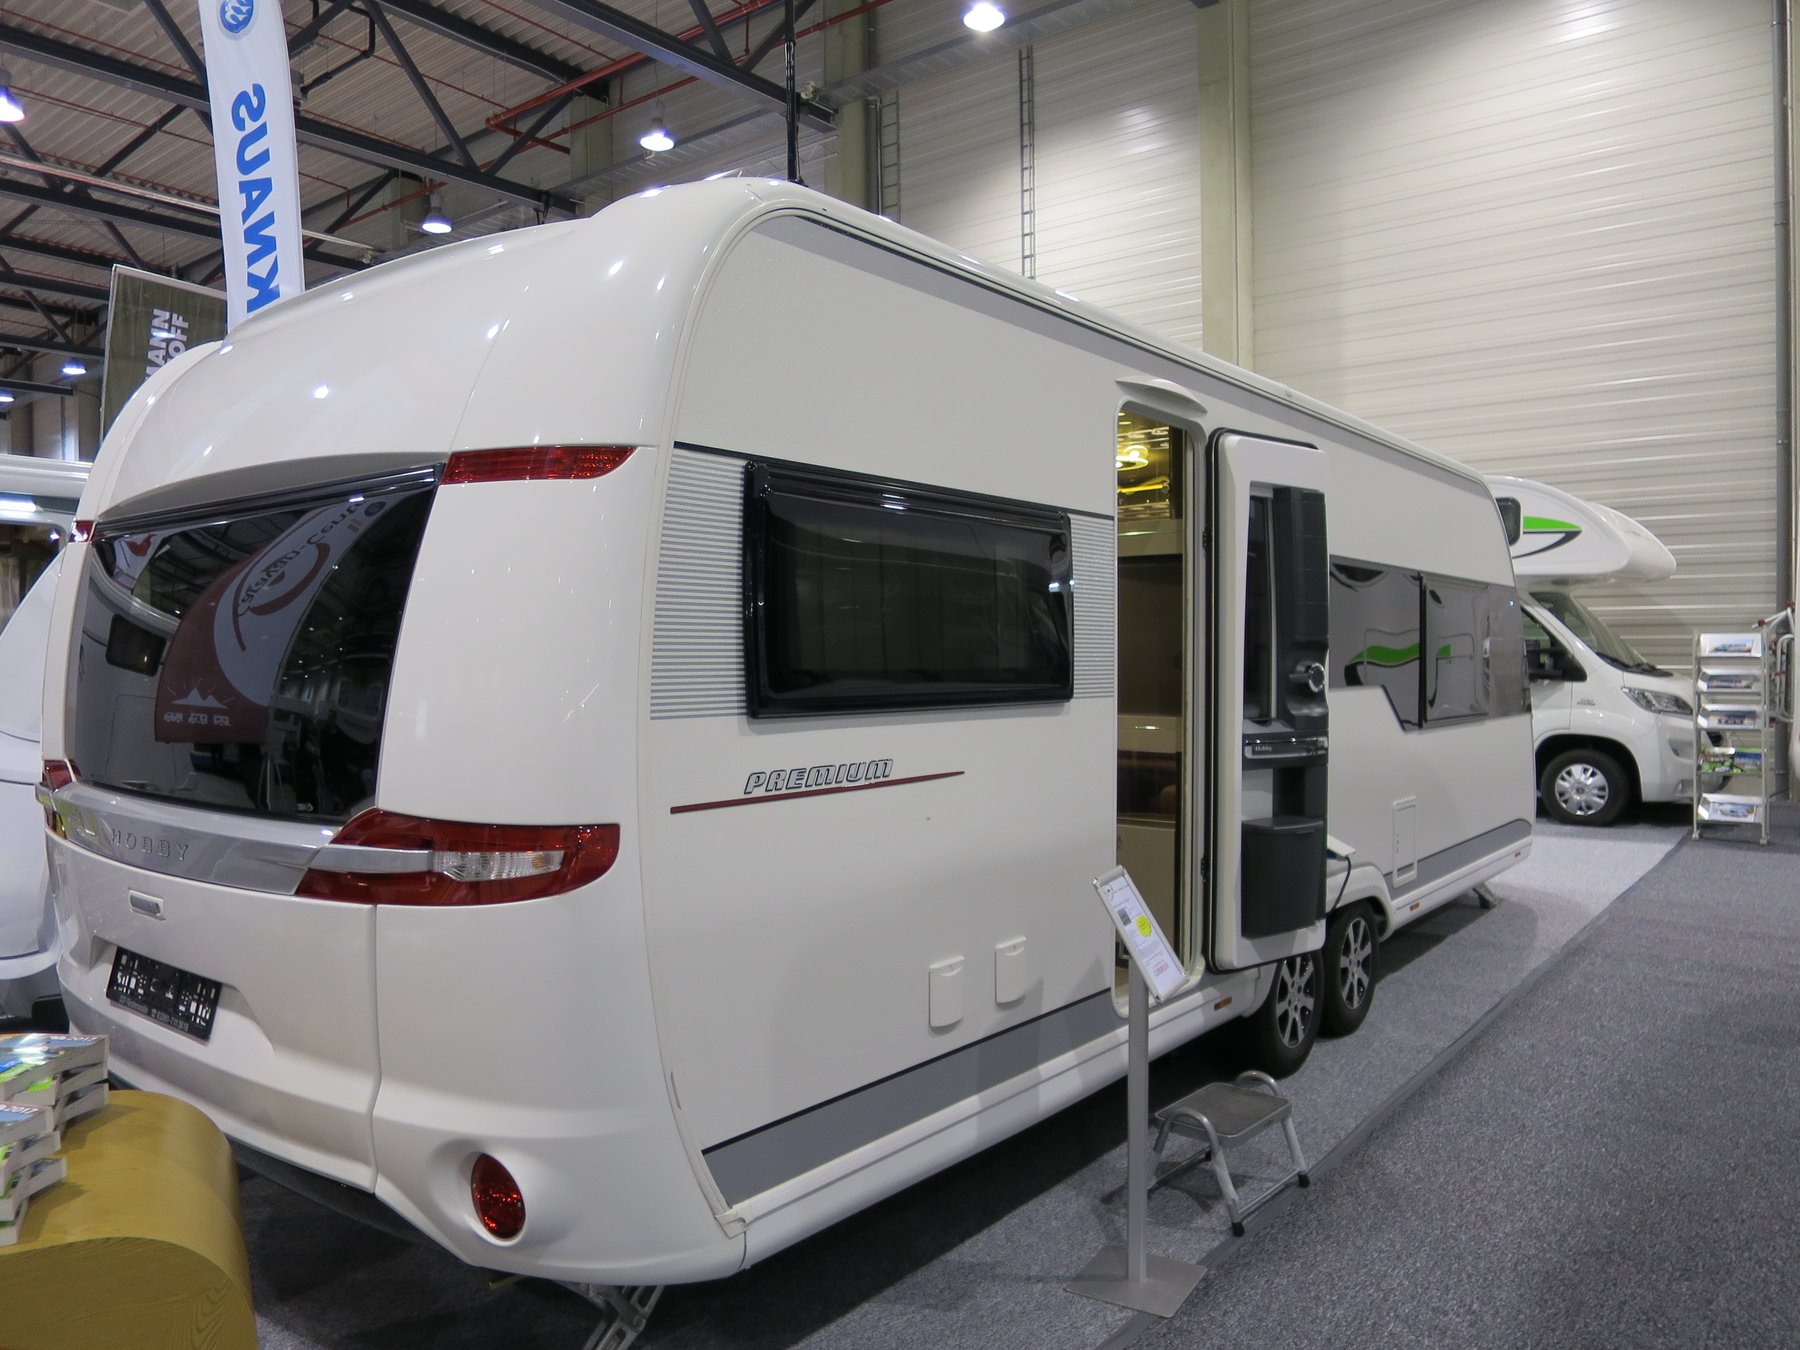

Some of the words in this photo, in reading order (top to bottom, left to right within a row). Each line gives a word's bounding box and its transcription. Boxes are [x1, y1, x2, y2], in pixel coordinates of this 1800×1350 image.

[167, 313, 189, 361] OFF
[744, 758, 893, 795] PREMIUM
[110, 828, 189, 861] HOBBY
[4, 1106, 39, 1115] 2017
